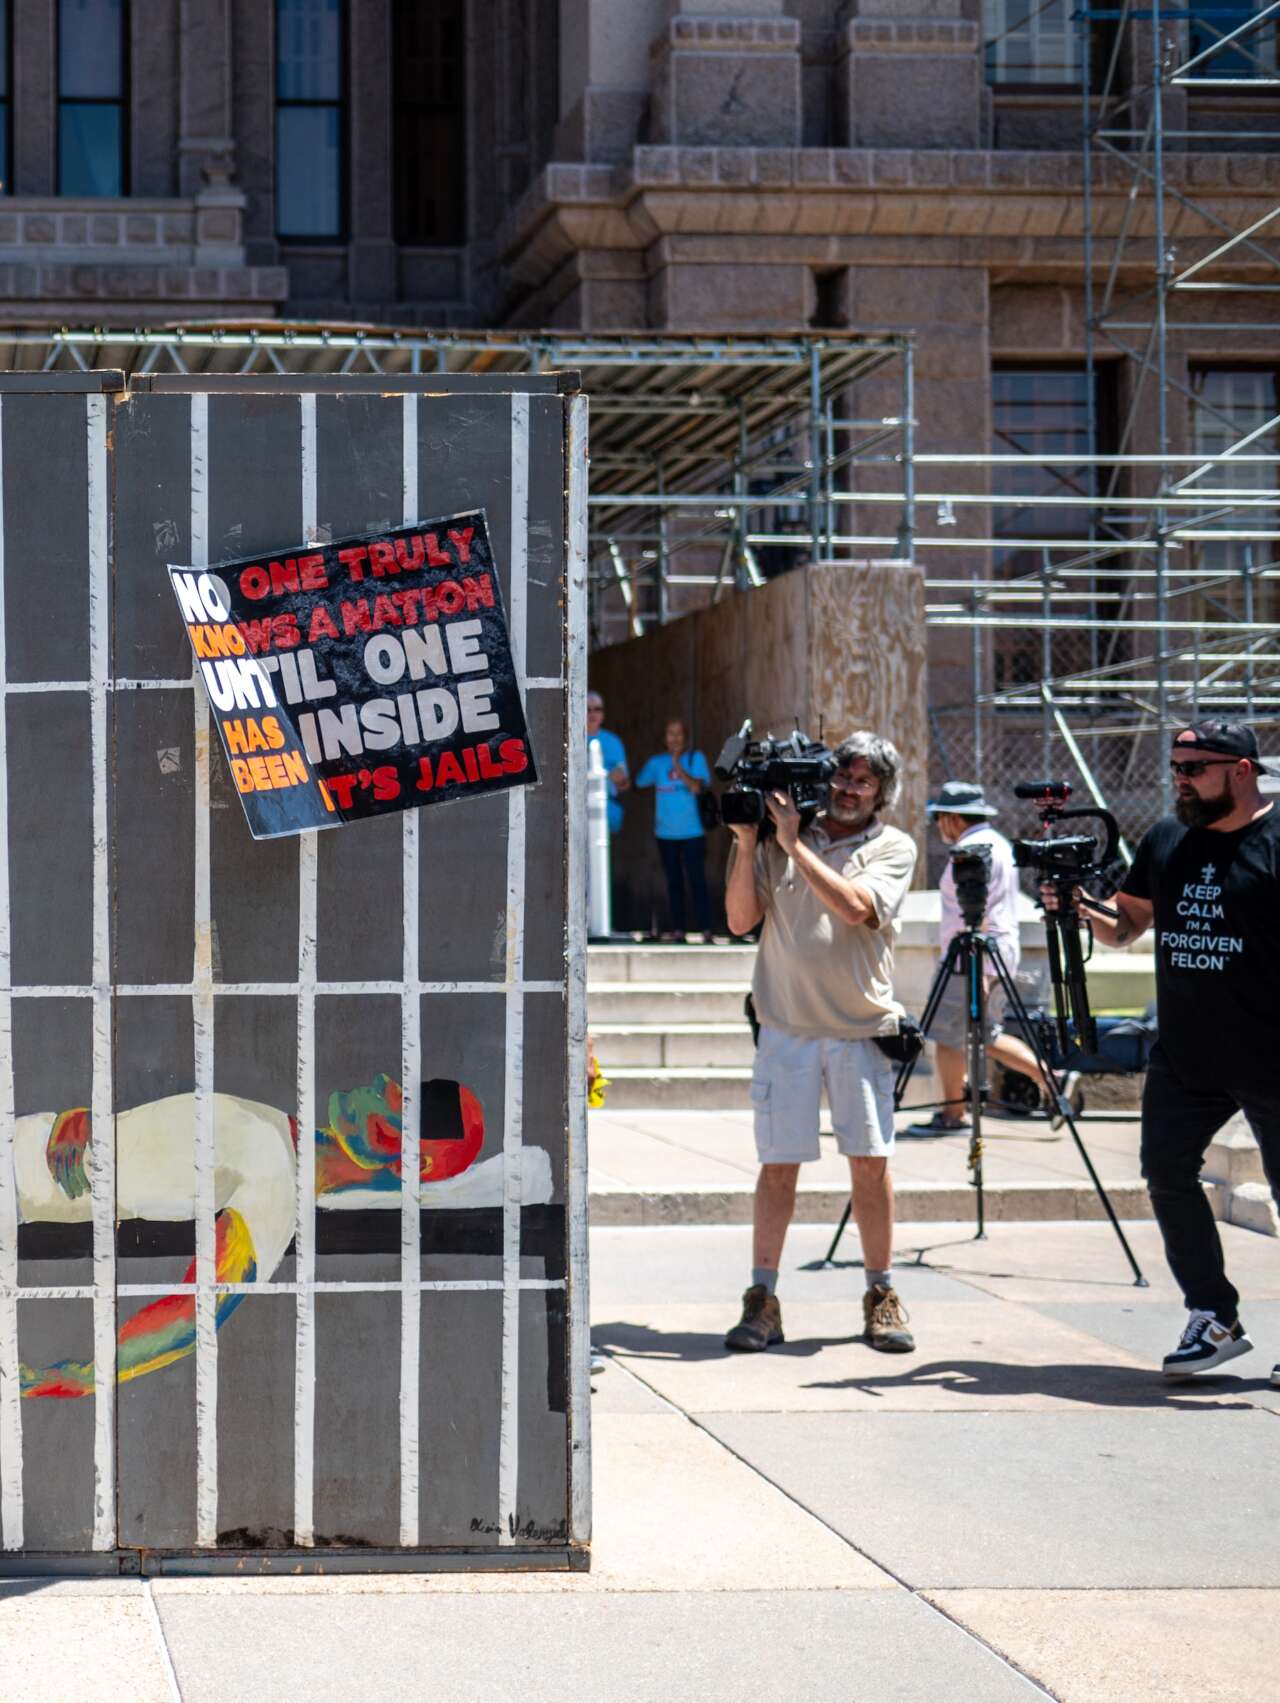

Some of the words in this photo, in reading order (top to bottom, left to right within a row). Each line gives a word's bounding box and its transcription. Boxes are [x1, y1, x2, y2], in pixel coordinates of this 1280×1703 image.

[172, 572, 231, 623] NO
[239, 555, 328, 600] ONE
[338, 527, 475, 582] TRULY
[188, 613, 301, 658] KNOWS
[308, 606, 340, 642] A
[340, 573, 495, 637] NATION
[200, 648, 337, 712] UNTIL
[364, 619, 488, 685] ONE
[222, 716, 285, 755] HAS
[298, 678, 500, 765] INSIDE
[230, 750, 309, 794] BEEN
[318, 766, 401, 812] IT'S
[415, 738, 528, 792] JAILS
[1176, 900, 1224, 919] CALM
[1182, 883, 1222, 901] KEEP
[1160, 931, 1244, 953] FORGIVEN
[1186, 919, 1200, 931] I'M
[1202, 921, 1211, 932] A
[1171, 951, 1224, 971] FELON
